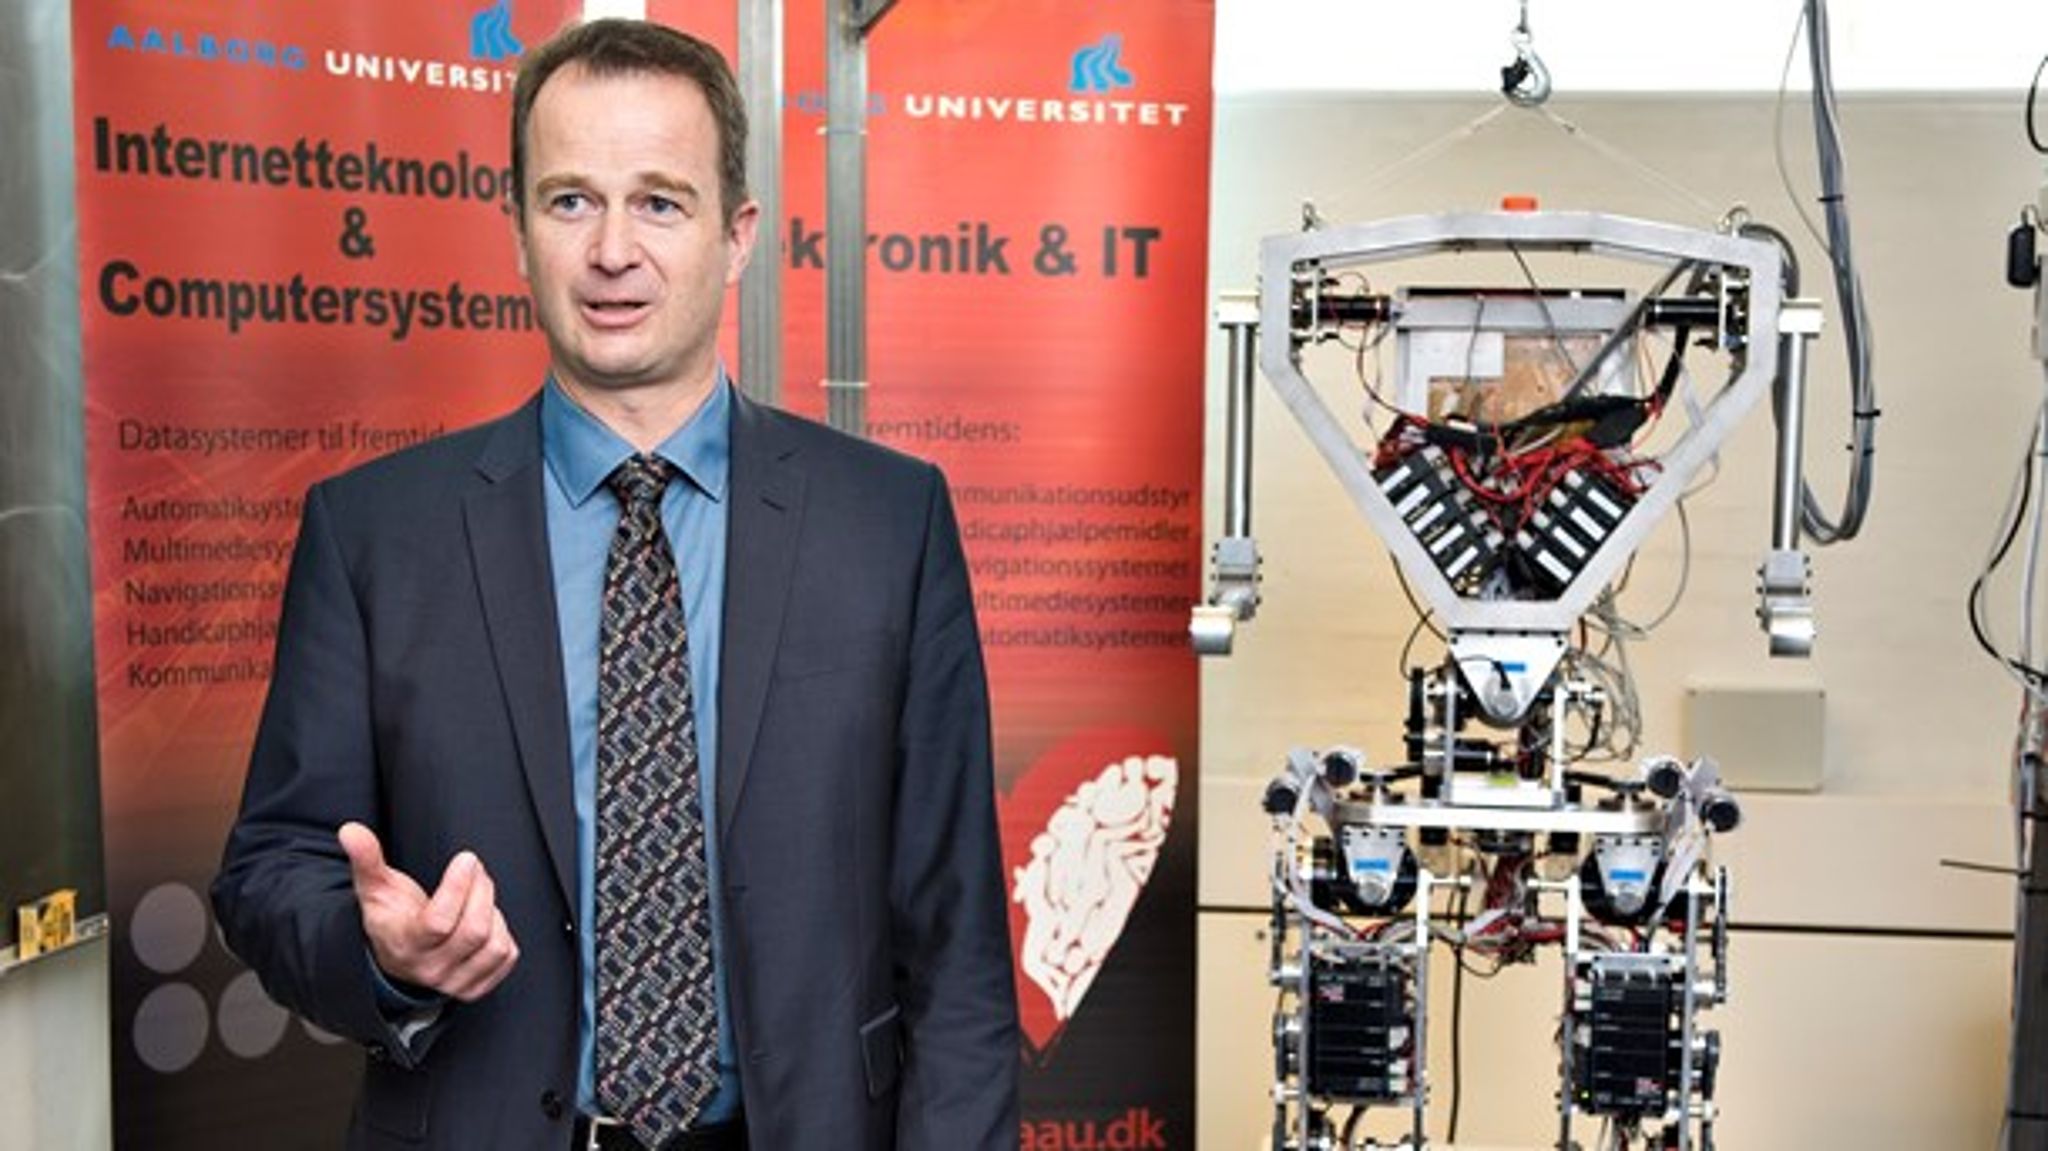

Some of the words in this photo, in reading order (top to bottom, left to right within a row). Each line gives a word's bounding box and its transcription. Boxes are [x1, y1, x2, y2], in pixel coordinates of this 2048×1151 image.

[108, 25, 306, 69] AALBORG
[905, 94, 1188, 126] UNIVERSITET
[339, 207, 374, 258] &
[1033, 225, 1077, 276] &
[1103, 227, 1161, 278] IT
[119, 419, 309, 456] Datasystemer
[319, 421, 343, 450] til
